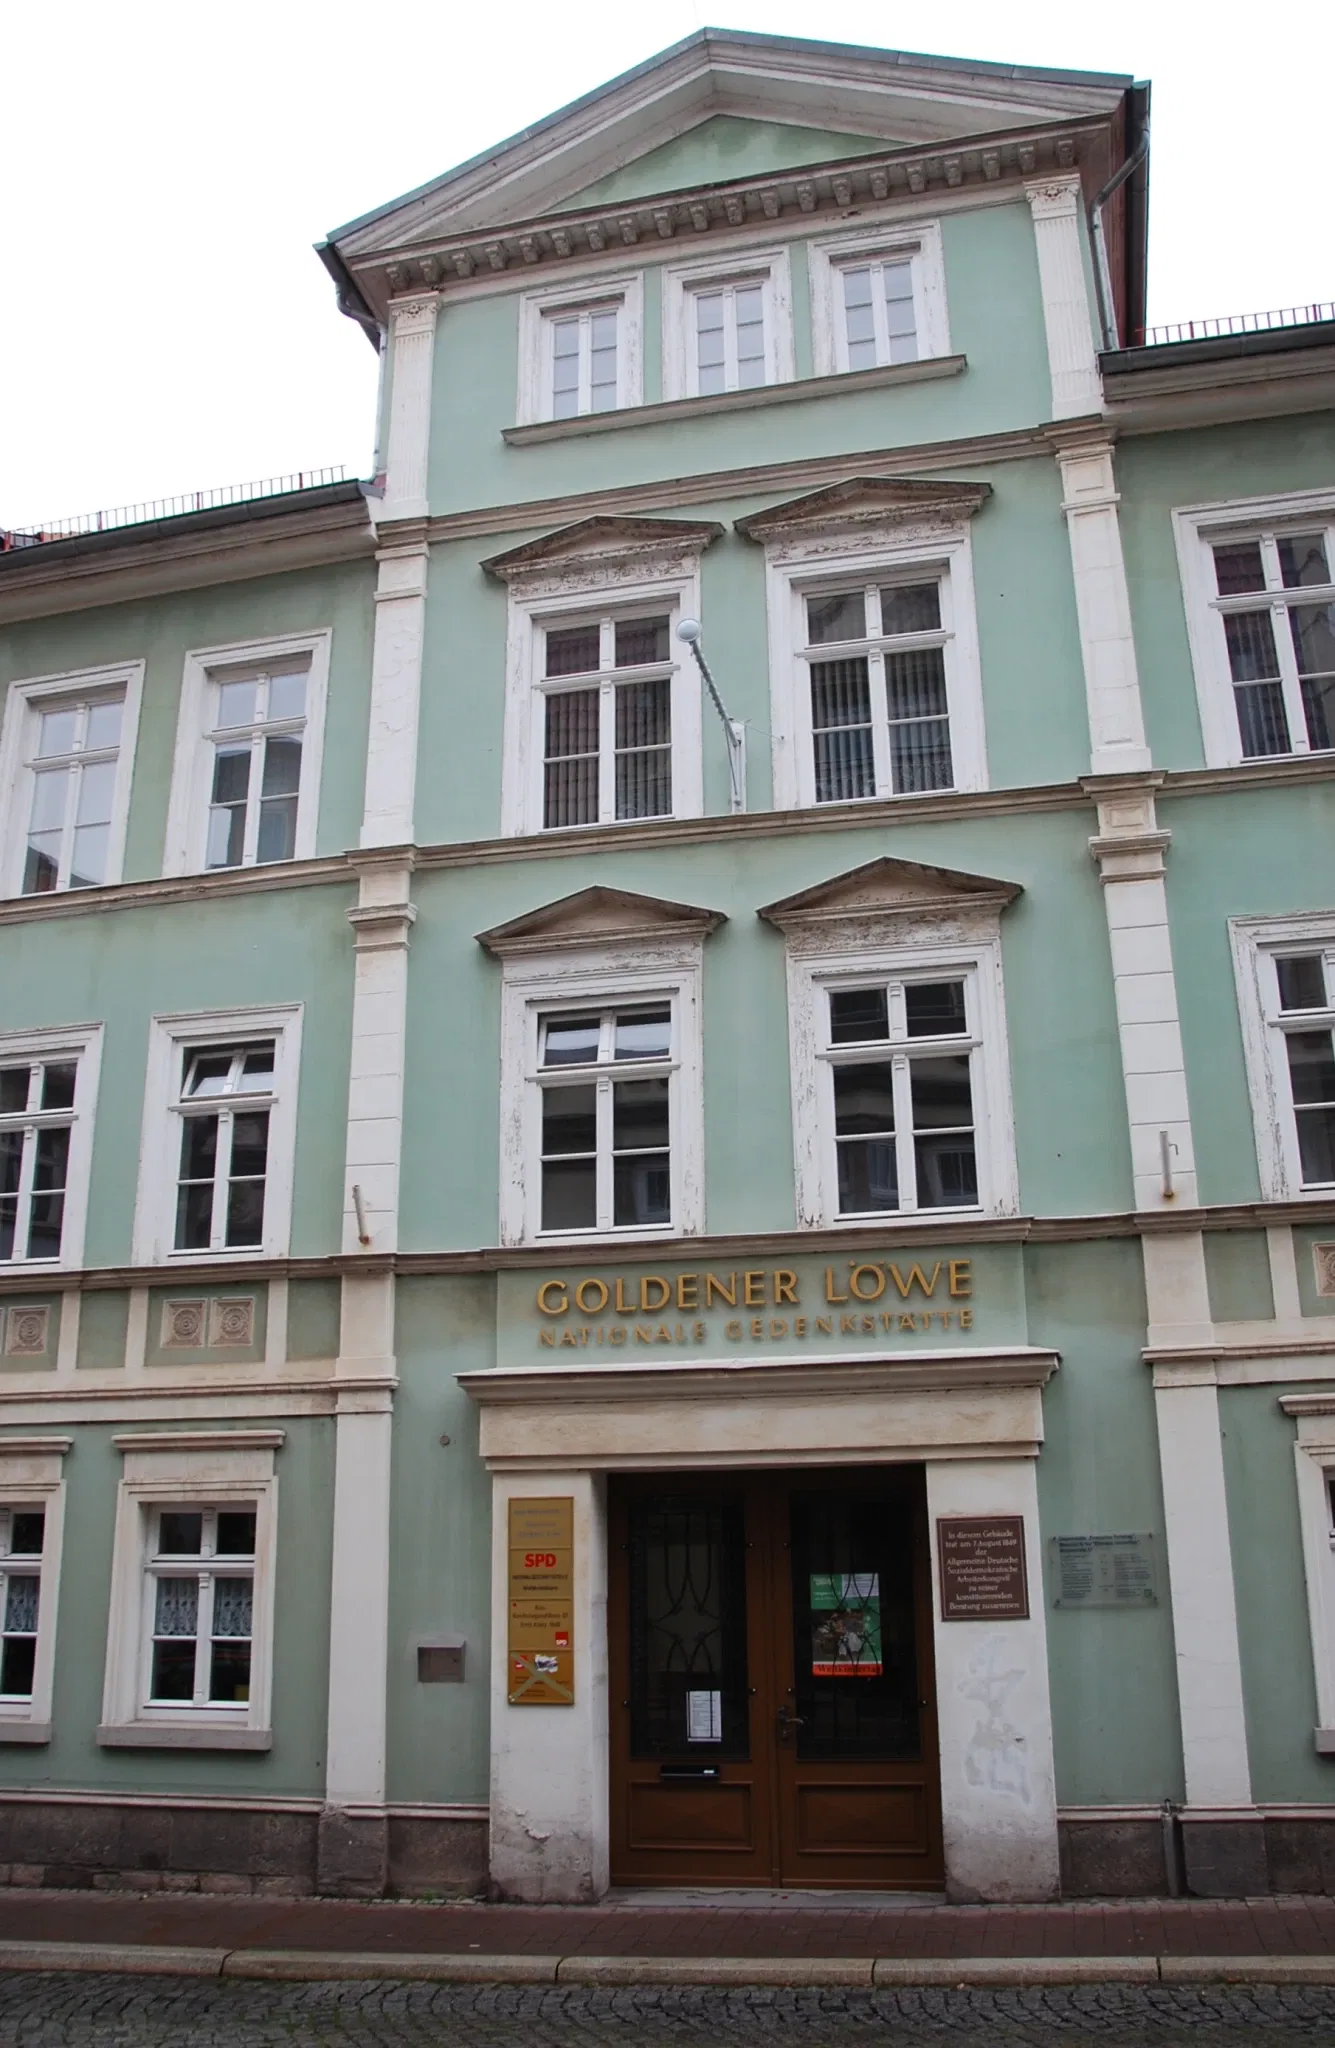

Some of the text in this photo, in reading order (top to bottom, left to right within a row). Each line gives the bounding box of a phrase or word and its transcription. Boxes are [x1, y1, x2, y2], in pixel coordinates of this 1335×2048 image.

[537, 1259, 973, 1315] GOLDENER LÖWE
[539, 1321, 706, 1346] NATIONALE
[982, 1529, 1014, 1538] Gebäude
[1002, 1538, 1017, 1546] 1849
[975, 1548, 988, 1556] der
[524, 1553, 557, 1568] SPD
[946, 1556, 1019, 1567] Allgemeine Deutsche
[947, 1565, 1019, 1575] Sozialdemokratische
[949, 1602, 1020, 1612] Beratung zusammen
